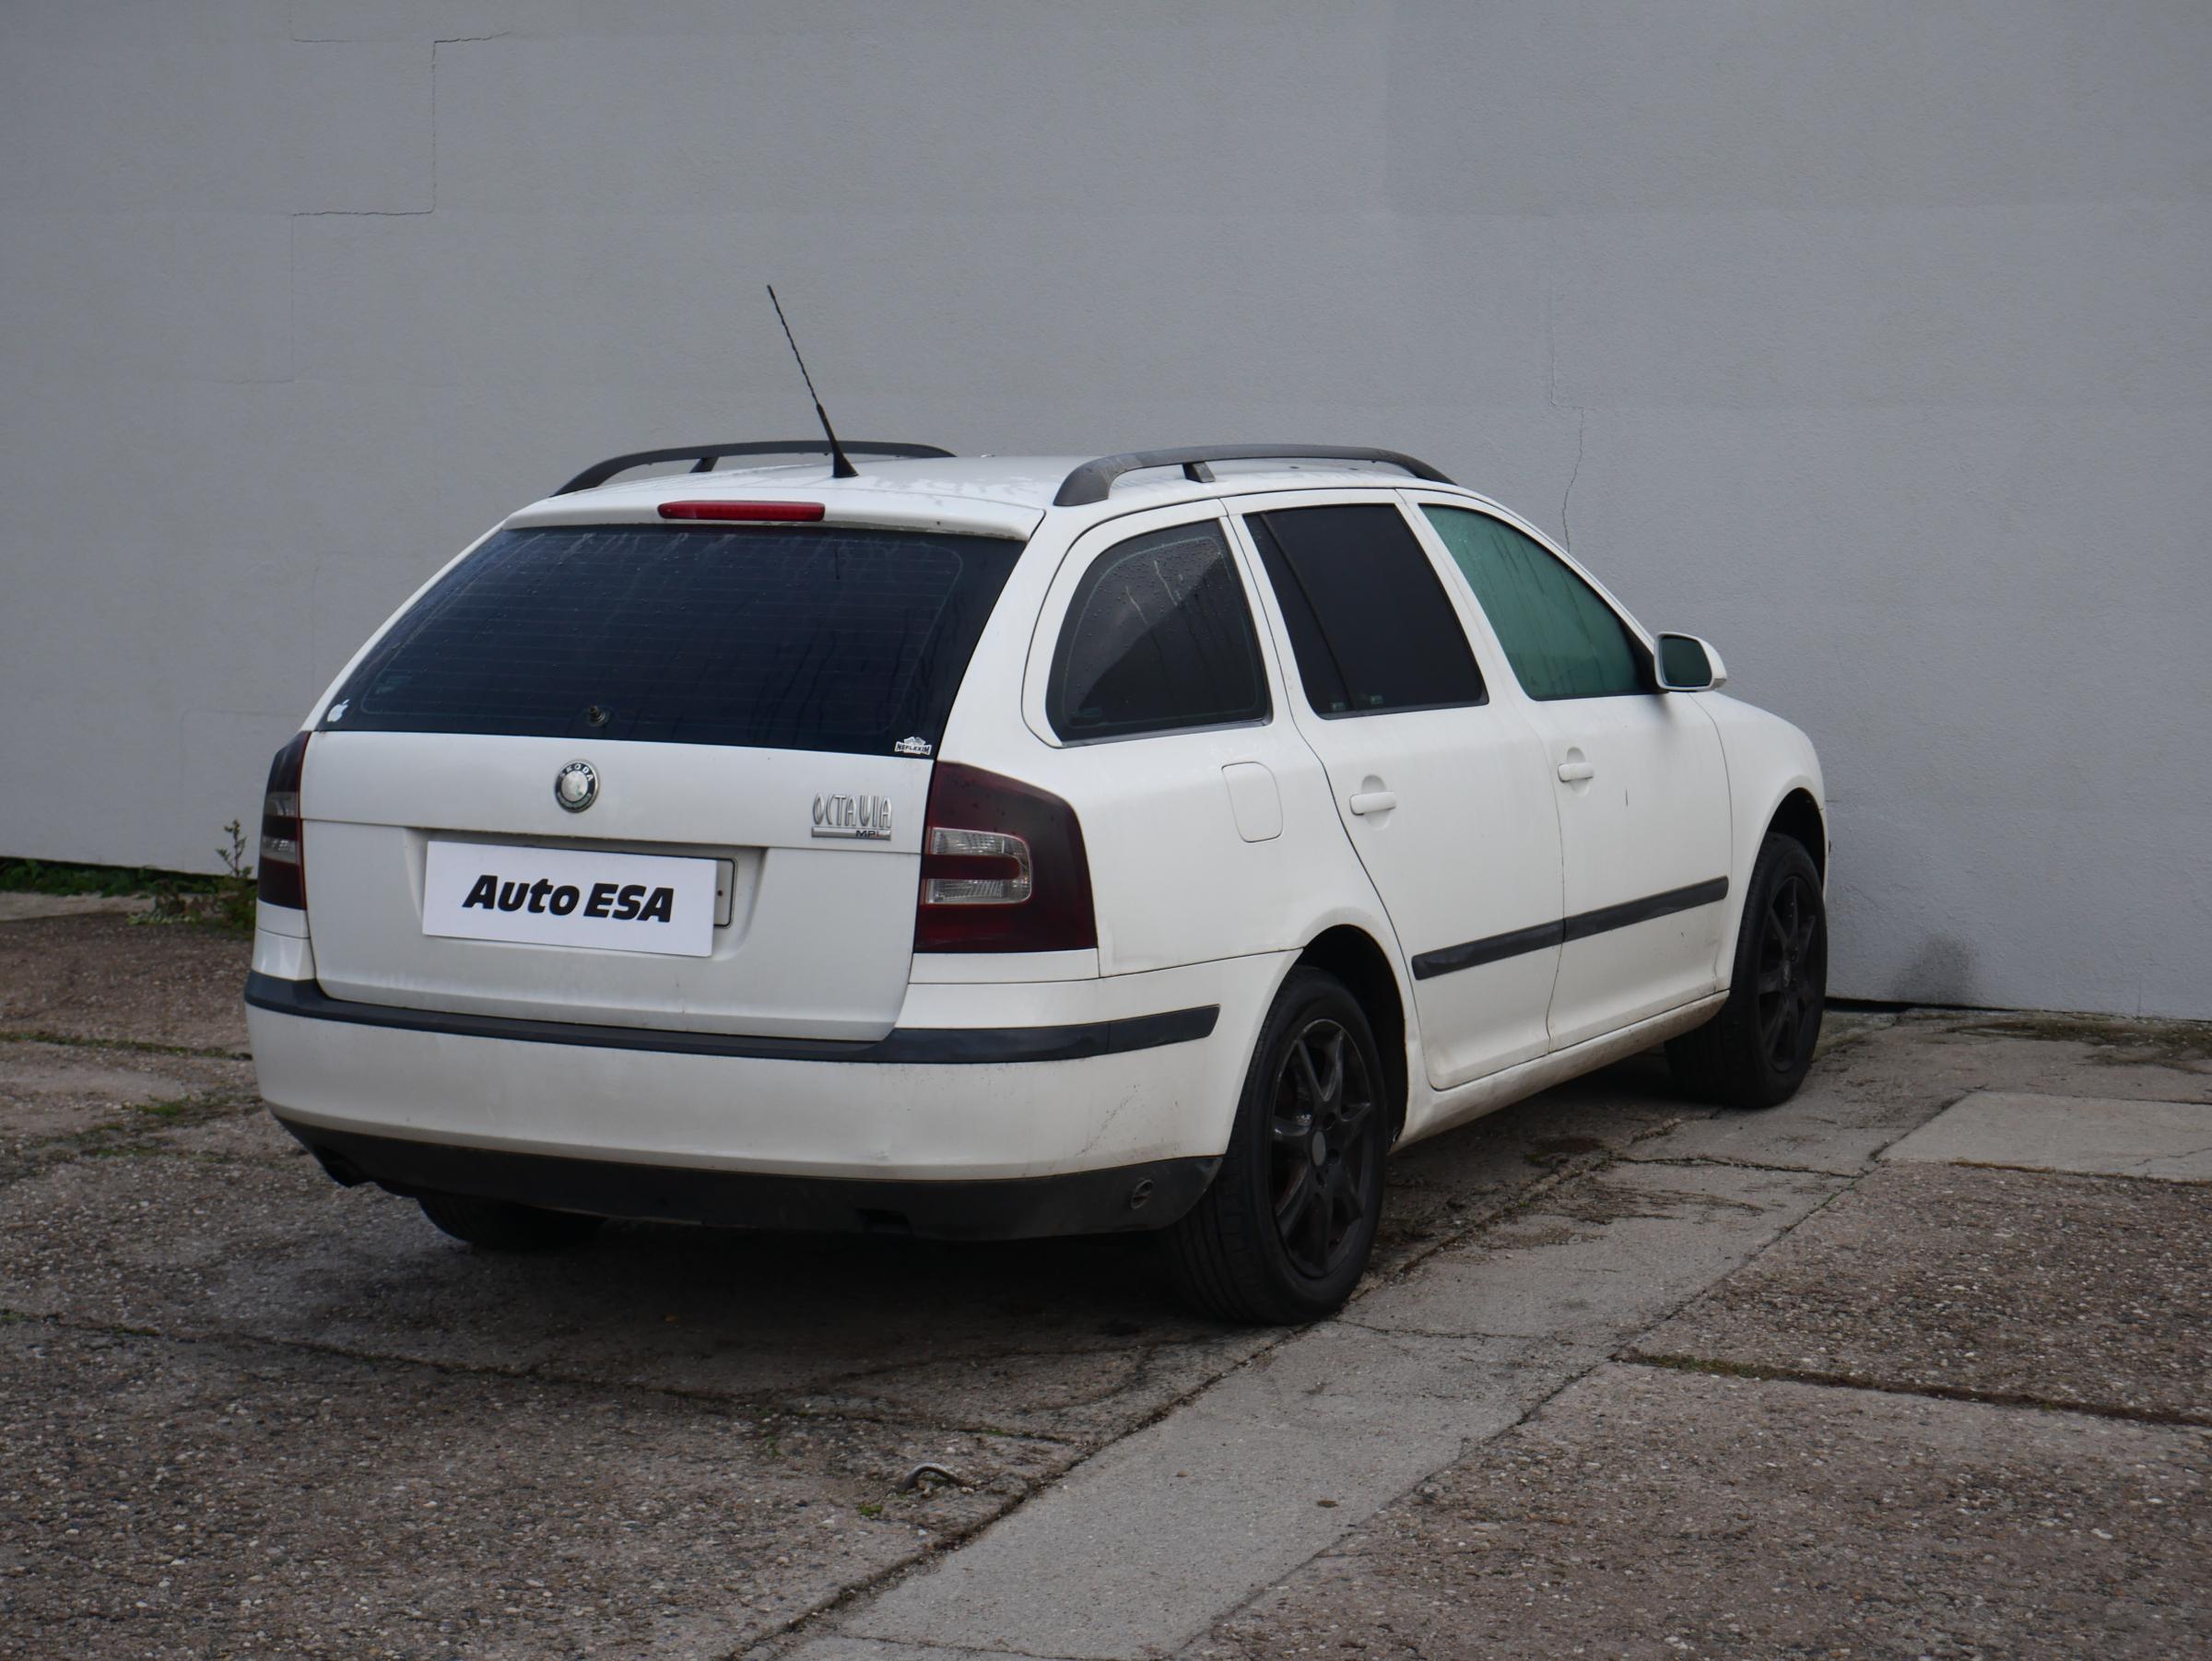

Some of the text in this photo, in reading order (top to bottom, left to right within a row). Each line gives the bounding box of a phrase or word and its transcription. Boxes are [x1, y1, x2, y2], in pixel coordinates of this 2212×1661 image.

[813, 794, 891, 828] OCTAVIA
[462, 875, 674, 923] Auto ESA
